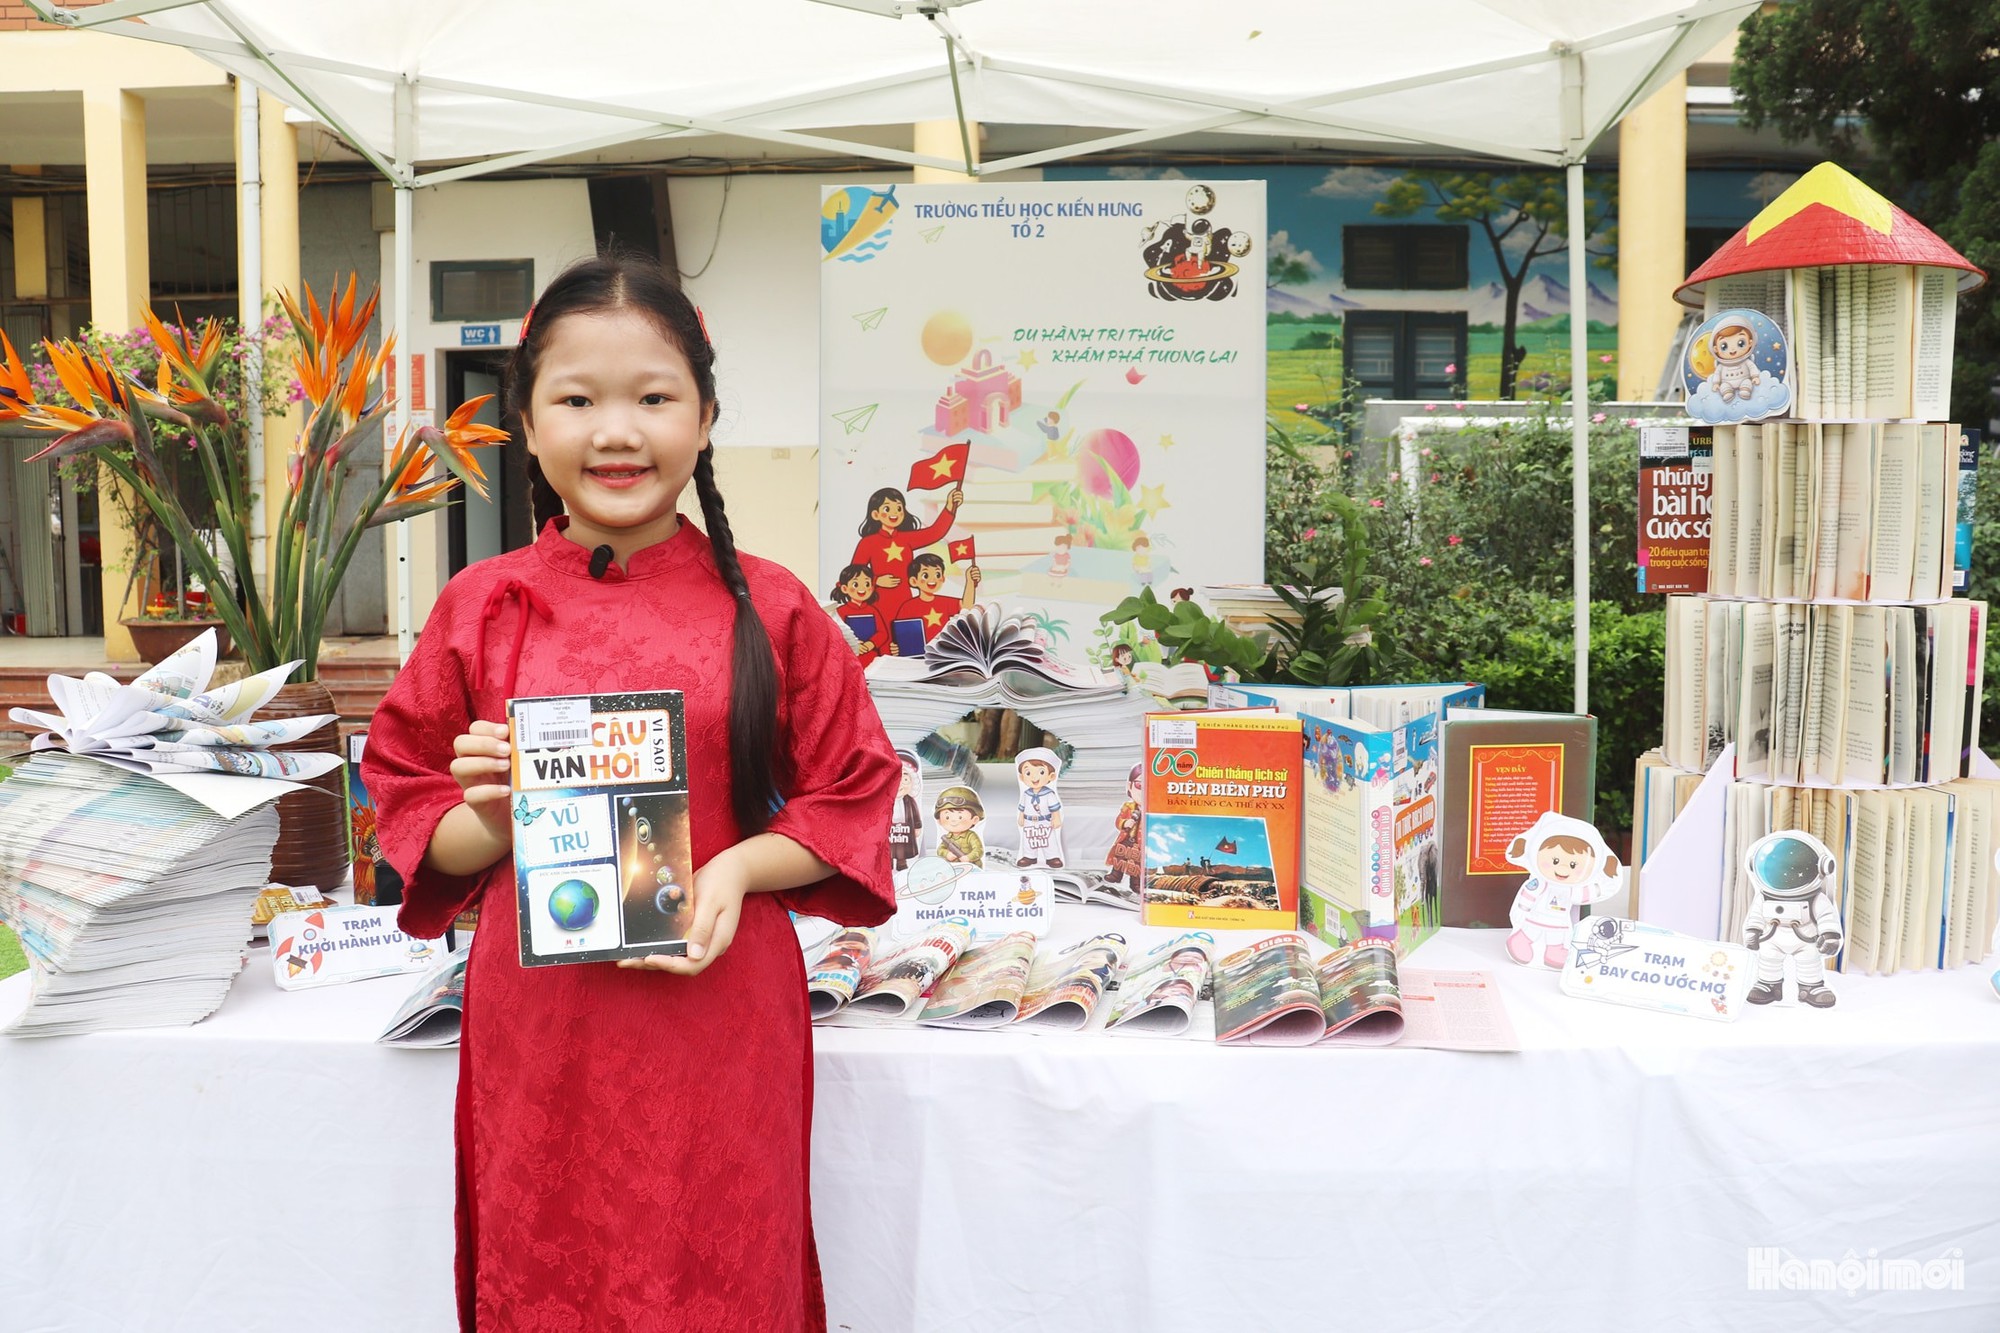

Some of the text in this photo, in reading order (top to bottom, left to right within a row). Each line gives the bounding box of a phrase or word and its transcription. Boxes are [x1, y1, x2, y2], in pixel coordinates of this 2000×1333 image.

[915, 197, 1143, 220] TRƯỜNG TIỂU HỌC KIẾN HƯNG
[1011, 218, 1045, 238] TỔ 2
[464, 329, 485, 339] WC
[1013, 328, 1038, 342] DU
[1041, 325, 1095, 342] HÀNH
[1097, 328, 1125, 342] TRI
[1052, 346, 1106, 363] KHÁM
[1107, 346, 1146, 363] PHÁ
[1208, 350, 1238, 363] LAI
[1653, 466, 1709, 492] những
[1653, 487, 1687, 516] bài
[1646, 517, 1692, 540] Cuộc
[1649, 546, 1660, 557] 20
[1679, 548, 1699, 559] quan
[1650, 559, 1671, 569] trong
[1671, 558, 1690, 569] cuộc
[592, 717, 647, 748] CÂU
[653, 738, 666, 773] SAO?
[1152, 748, 1199, 777] 60
[533, 755, 586, 784] VẠN
[1195, 764, 1289, 782] Chiến thắng lịch sử
[1167, 780, 1287, 799] ĐIỆN BIÊN PHỦ
[1190, 797, 1217, 807] HÙNG
[1219, 800, 1233, 808] CA
[1235, 798, 1254, 809] THẾ
[551, 803, 579, 826] VŨ
[549, 830, 589, 853] TRỤ
[960, 891, 996, 904] TRẠM
[916, 905, 956, 920] KHÁM
[988, 901, 1013, 918] THẾ
[1015, 904, 1043, 917] GIỚI
[343, 917, 382, 932] TRẠM
[298, 937, 336, 955] KHỞI
[339, 934, 381, 950] HÀNH
[382, 930, 402, 945] VŨ
[1644, 952, 1685, 969] TRẠM
[1600, 965, 1727, 995] BAY CAO ƯỚC MƠ
